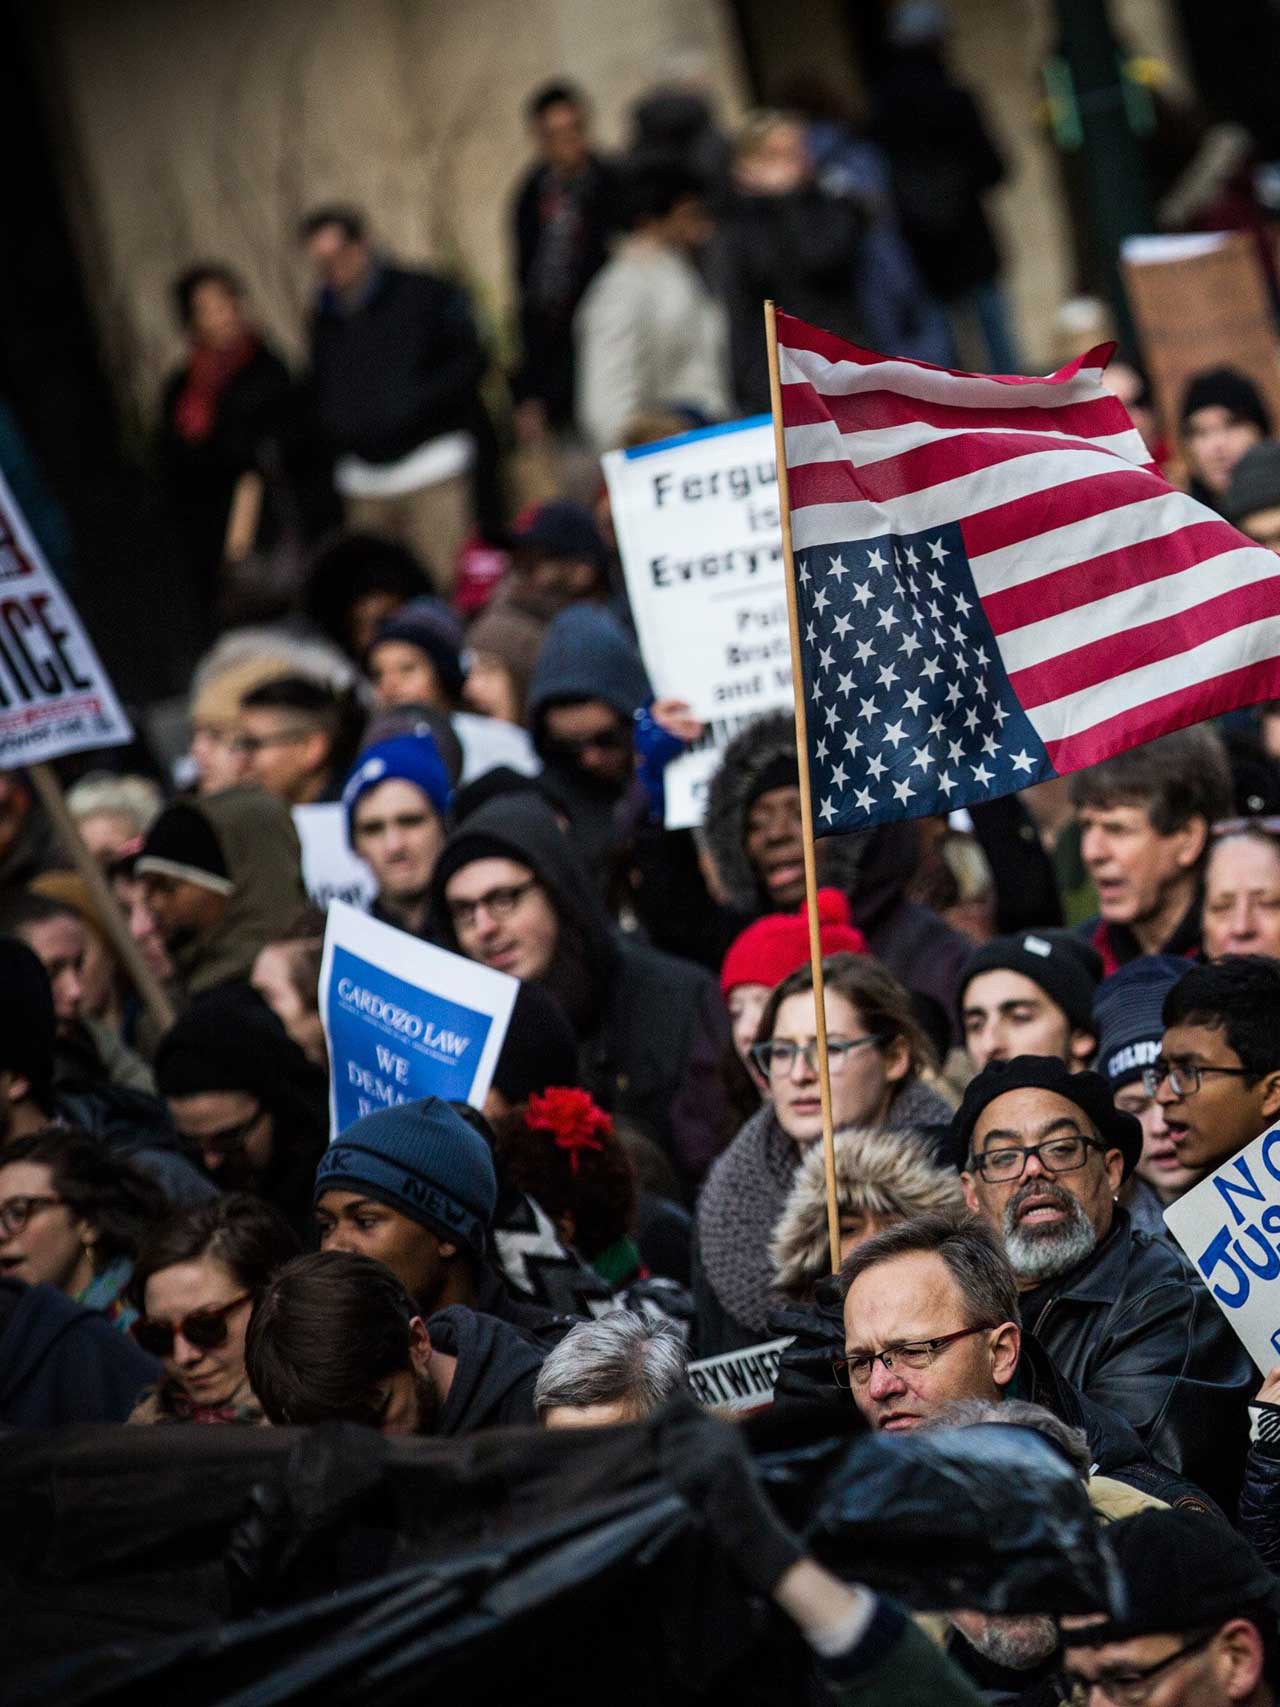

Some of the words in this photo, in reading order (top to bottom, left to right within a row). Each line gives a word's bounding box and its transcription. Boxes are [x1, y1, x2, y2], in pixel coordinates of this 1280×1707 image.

[0, 592, 92, 707] ICE
[337, 976, 424, 1038] CARDOZO
[424, 1022, 472, 1058] LAW
[376, 1043, 411, 1086] WE
[402, 1176, 466, 1224] NEW
